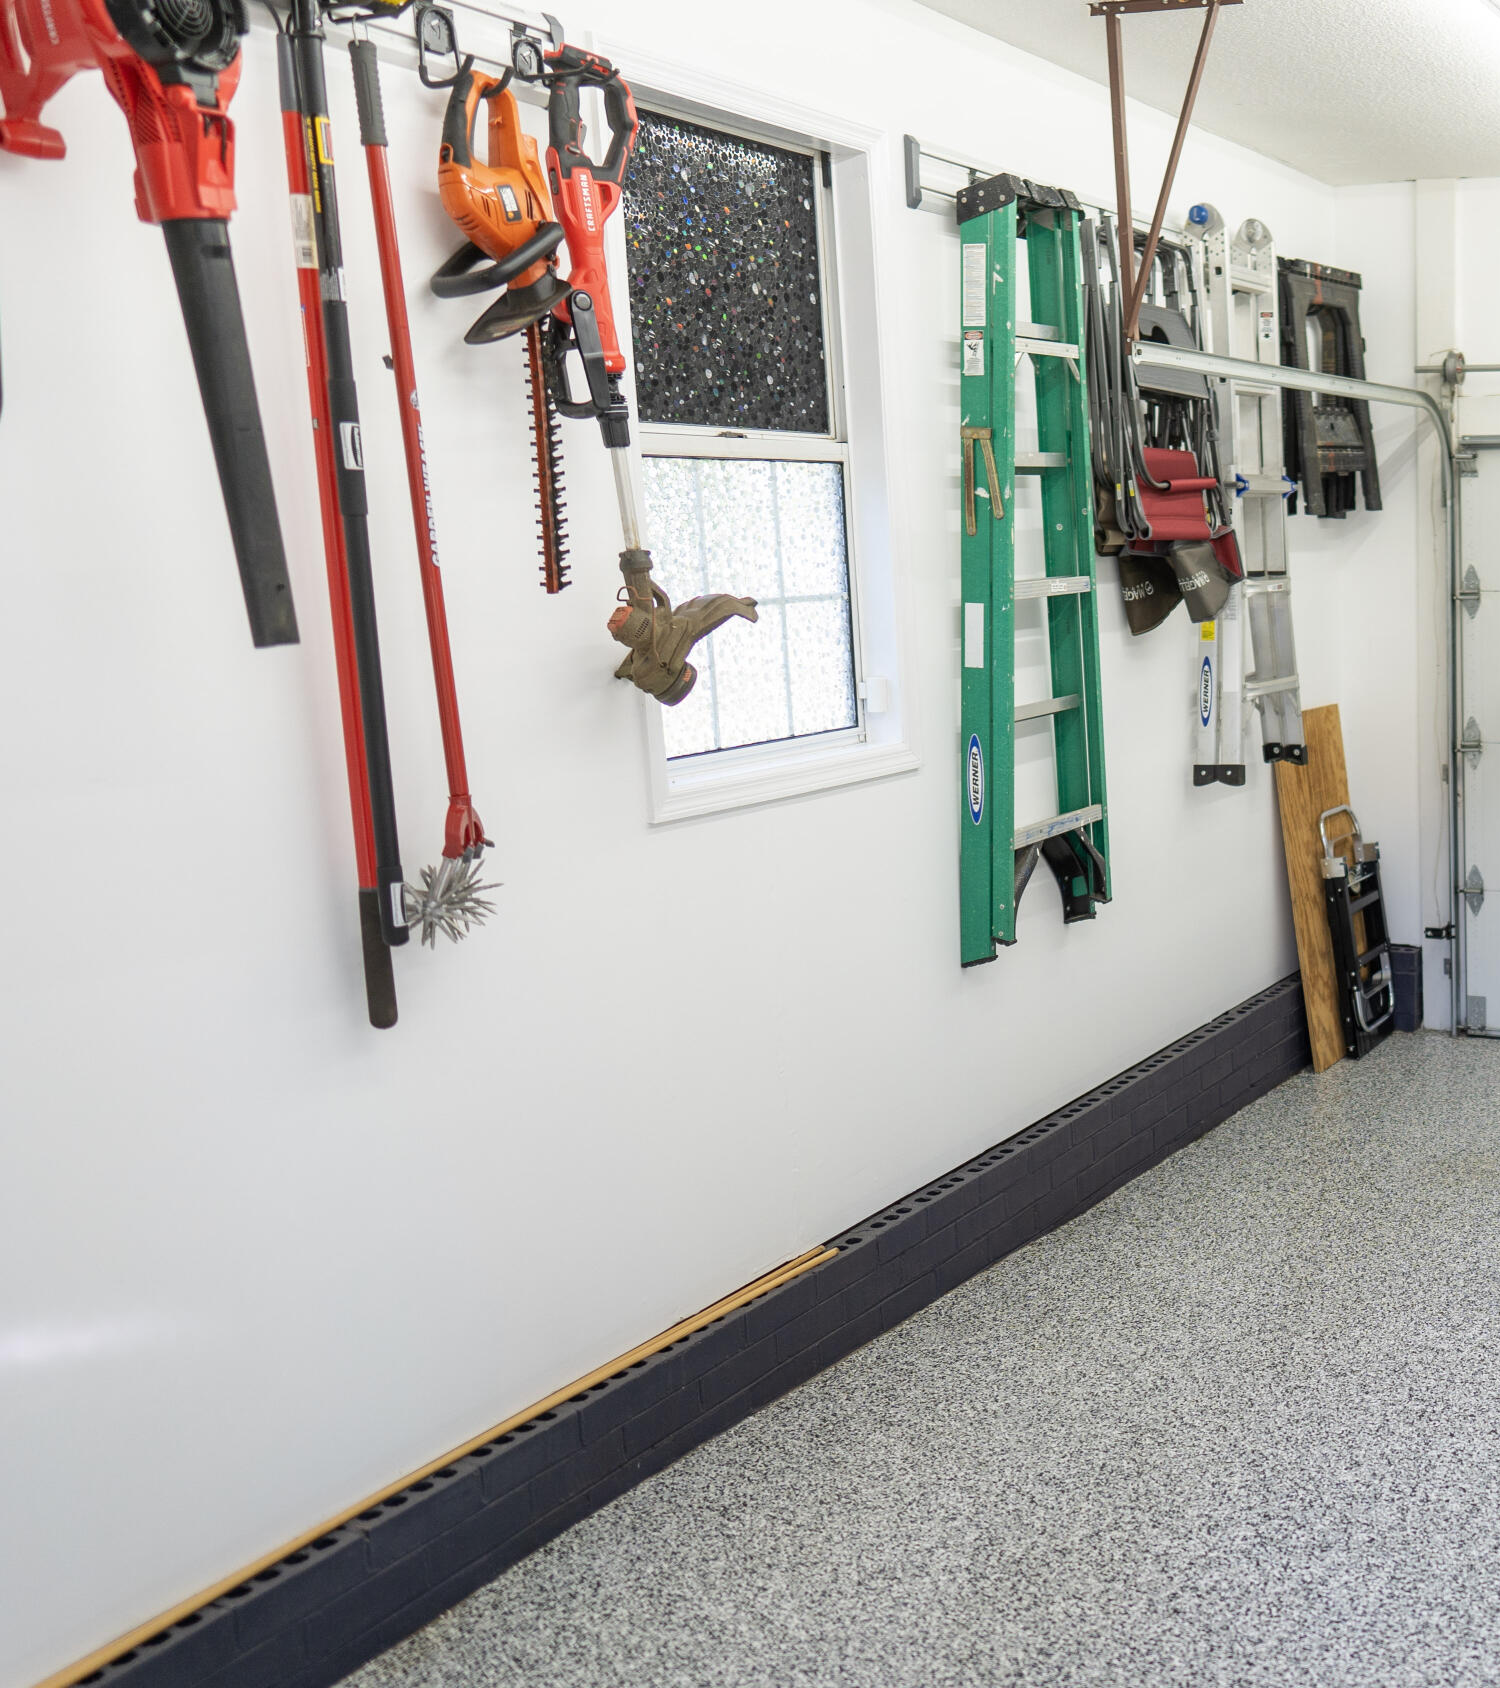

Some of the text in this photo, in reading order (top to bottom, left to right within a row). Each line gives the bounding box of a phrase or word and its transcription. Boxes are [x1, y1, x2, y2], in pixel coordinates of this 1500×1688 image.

[580, 174, 596, 232] CRAFTSMAN
[1202, 669, 1210, 713] WERNER
[971, 751, 980, 806] WERNER
